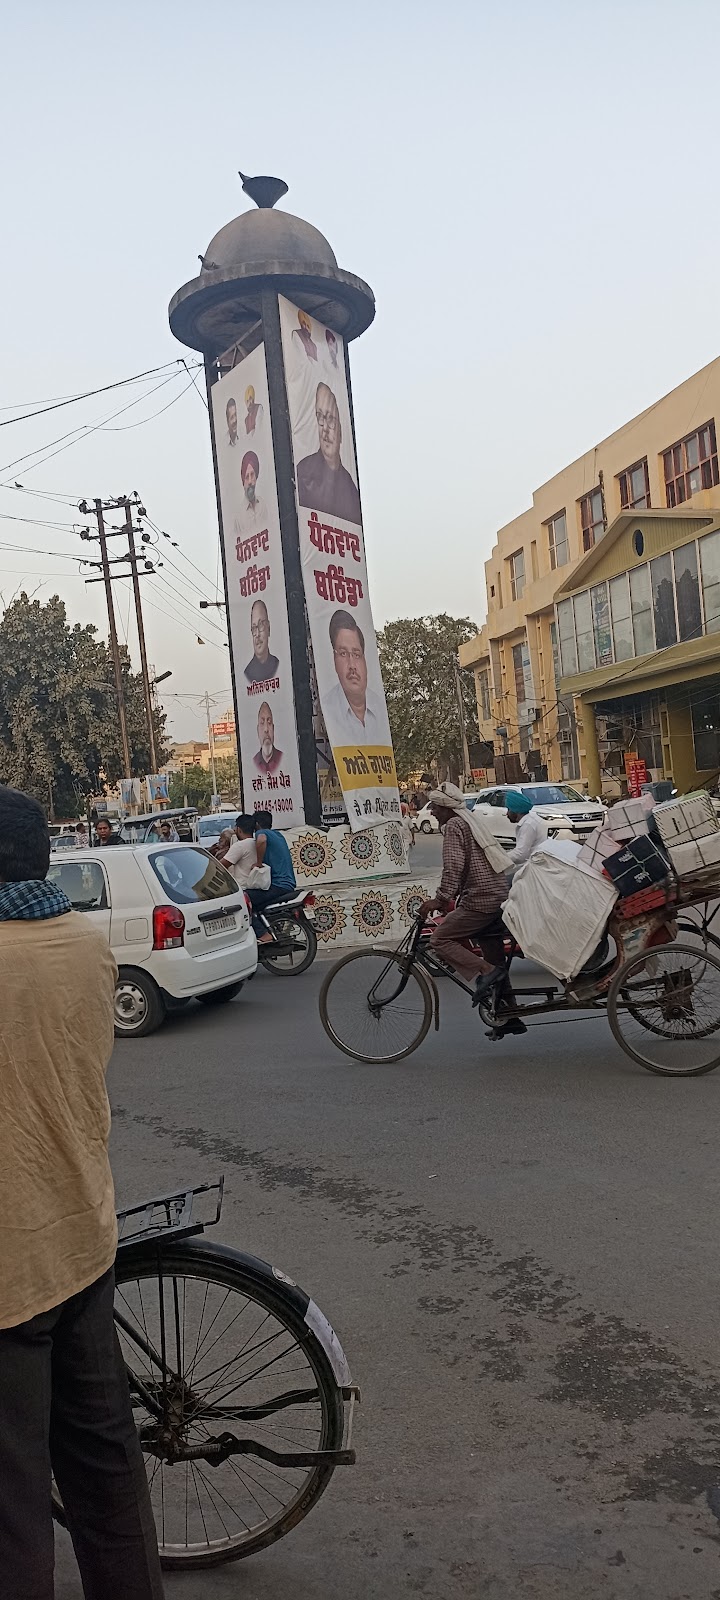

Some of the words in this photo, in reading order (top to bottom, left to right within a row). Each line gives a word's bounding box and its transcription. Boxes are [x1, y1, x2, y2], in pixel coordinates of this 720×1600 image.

[235, 528, 270, 563] ਧੰਨਵਾਦ
[307, 511, 361, 562] ਧੰਨਵਾਦ
[239, 564, 271, 597] ਬਠਿੰਡਾ
[313, 564, 364, 607] ਬਠਿੰਡਾ
